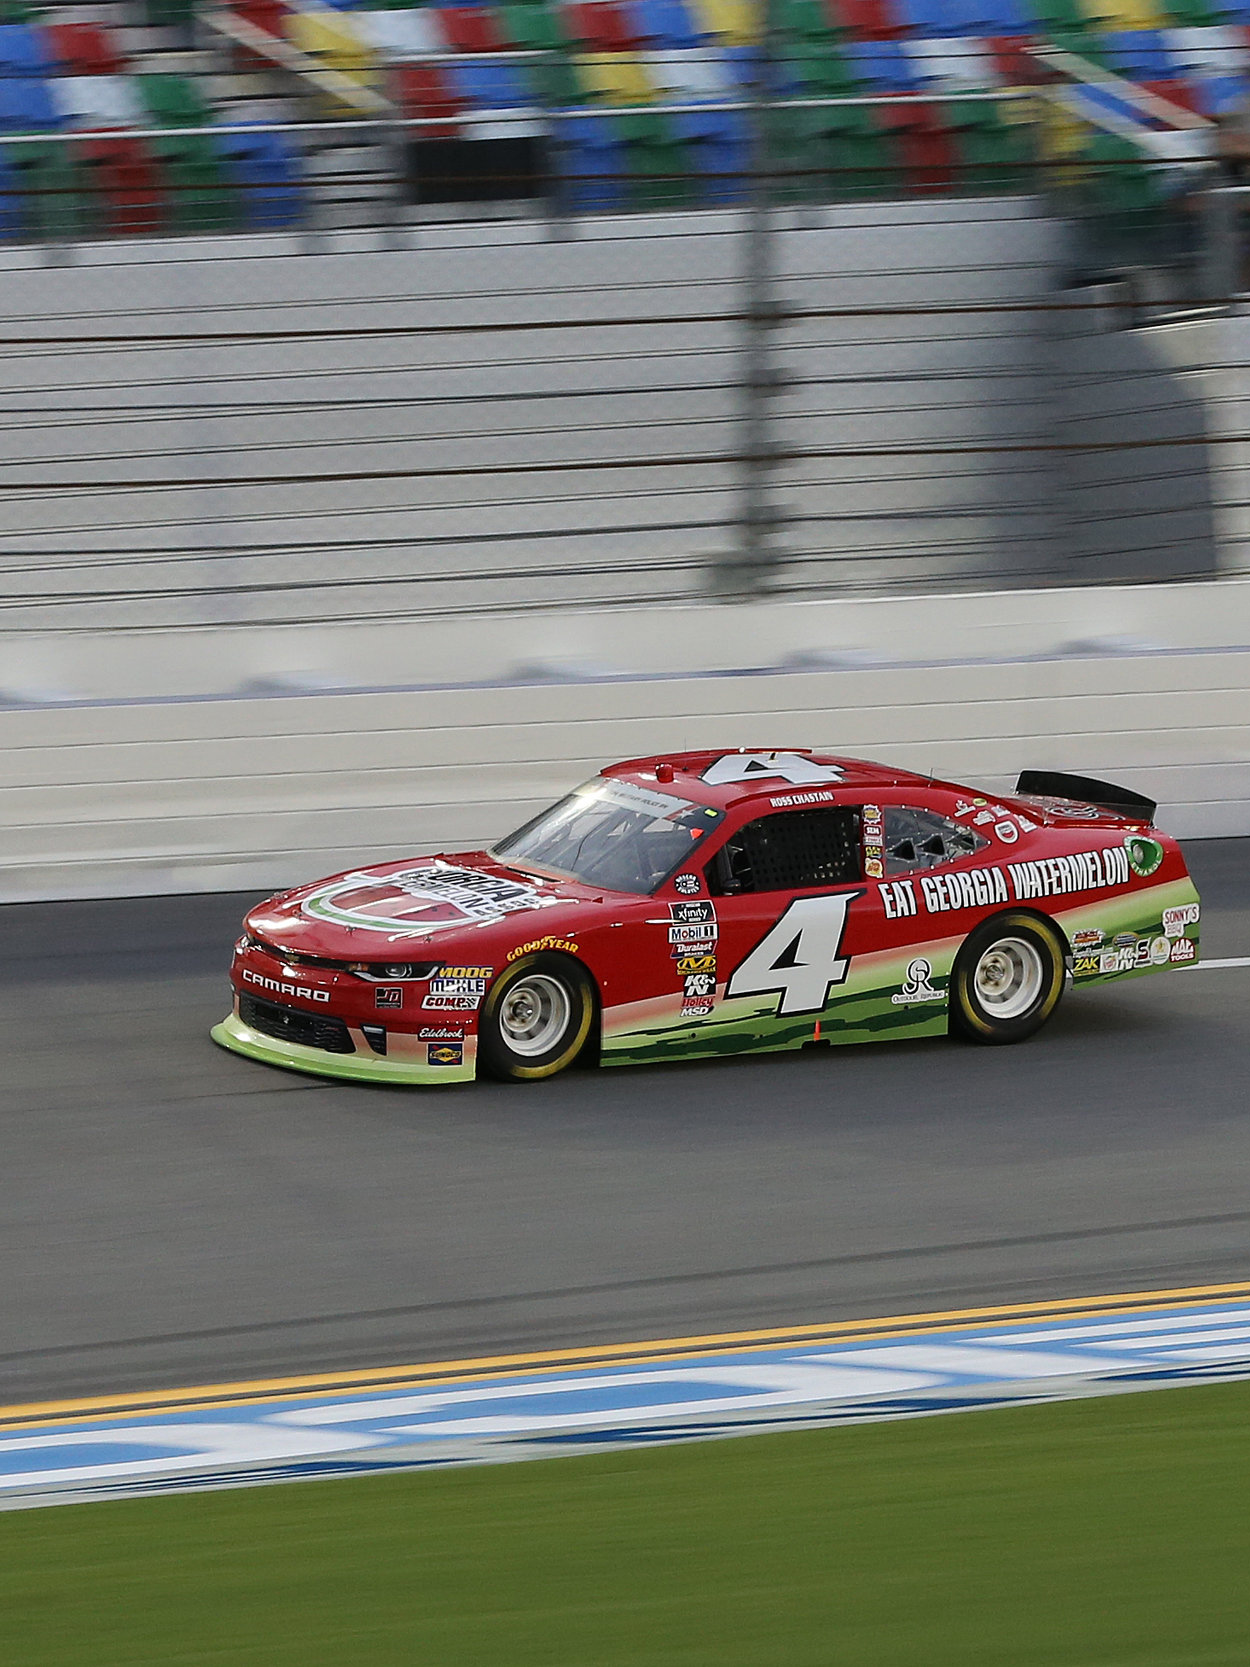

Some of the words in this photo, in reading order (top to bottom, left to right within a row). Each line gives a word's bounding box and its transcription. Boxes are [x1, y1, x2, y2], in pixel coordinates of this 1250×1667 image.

[700, 753, 852, 786] 4
[770, 795, 792, 808] ROSS
[793, 791, 835, 805] CHASTAIN
[878, 879, 918, 919] EAT
[919, 867, 1008, 913] GEORGIA
[1007, 846, 1131, 901] WATERMELON
[678, 908, 708, 921] xfinity
[1164, 906, 1197, 925] SONNY'S
[671, 926, 701, 940] Mobil
[704, 925, 714, 937] 1
[506, 935, 580, 962] GOODYEAR
[676, 941, 713, 953] Duralast
[725, 889, 861, 1017] 4
[1073, 956, 1099, 971] ZAK
[439, 966, 494, 978] MOOG
[242, 968, 331, 1003] CAMARO
[426, 996, 466, 1008] COMP
[680, 1006, 710, 1017] MSD
[419, 1027, 464, 1038] Edelbrock
